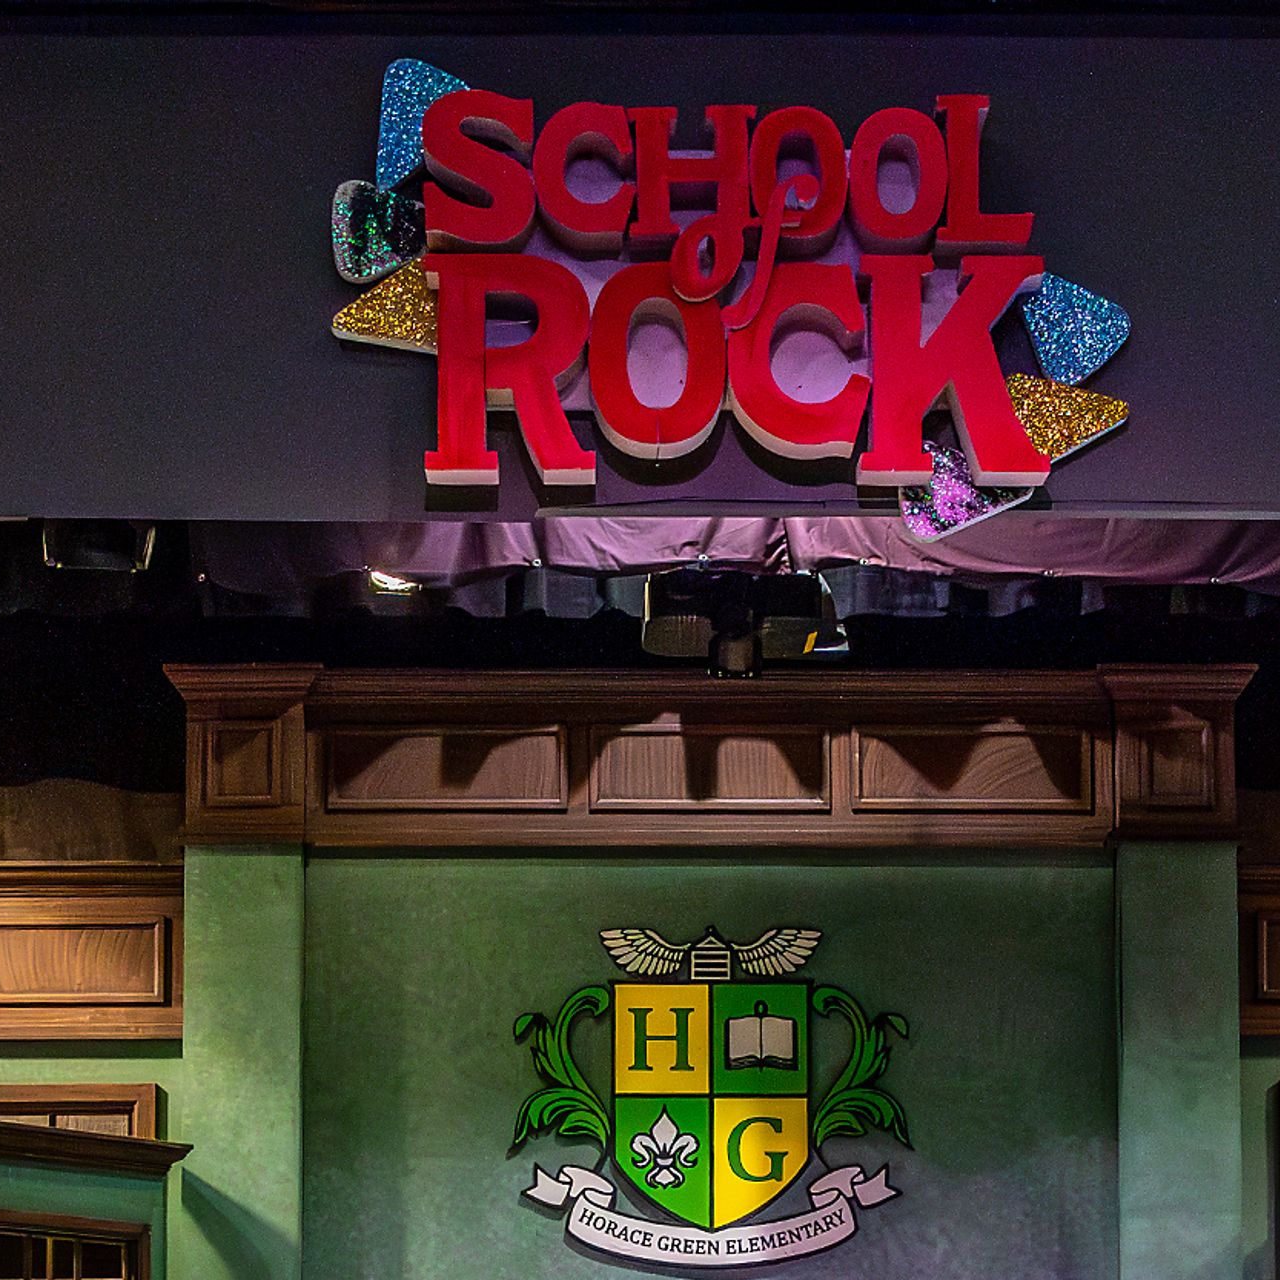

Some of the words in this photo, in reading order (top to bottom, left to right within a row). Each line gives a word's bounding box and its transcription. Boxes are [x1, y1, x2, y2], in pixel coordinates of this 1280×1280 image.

[422, 89, 1034, 252] SCHOOL
[671, 174, 820, 330] of
[423, 254, 1052, 486] ROCK
[627, 1007, 695, 1072] H
[726, 1116, 788, 1183] G
[578, 1207, 653, 1248] HORACE
[657, 1235, 720, 1256] GREEN
[725, 1208, 846, 1255] ELEMENTARY
